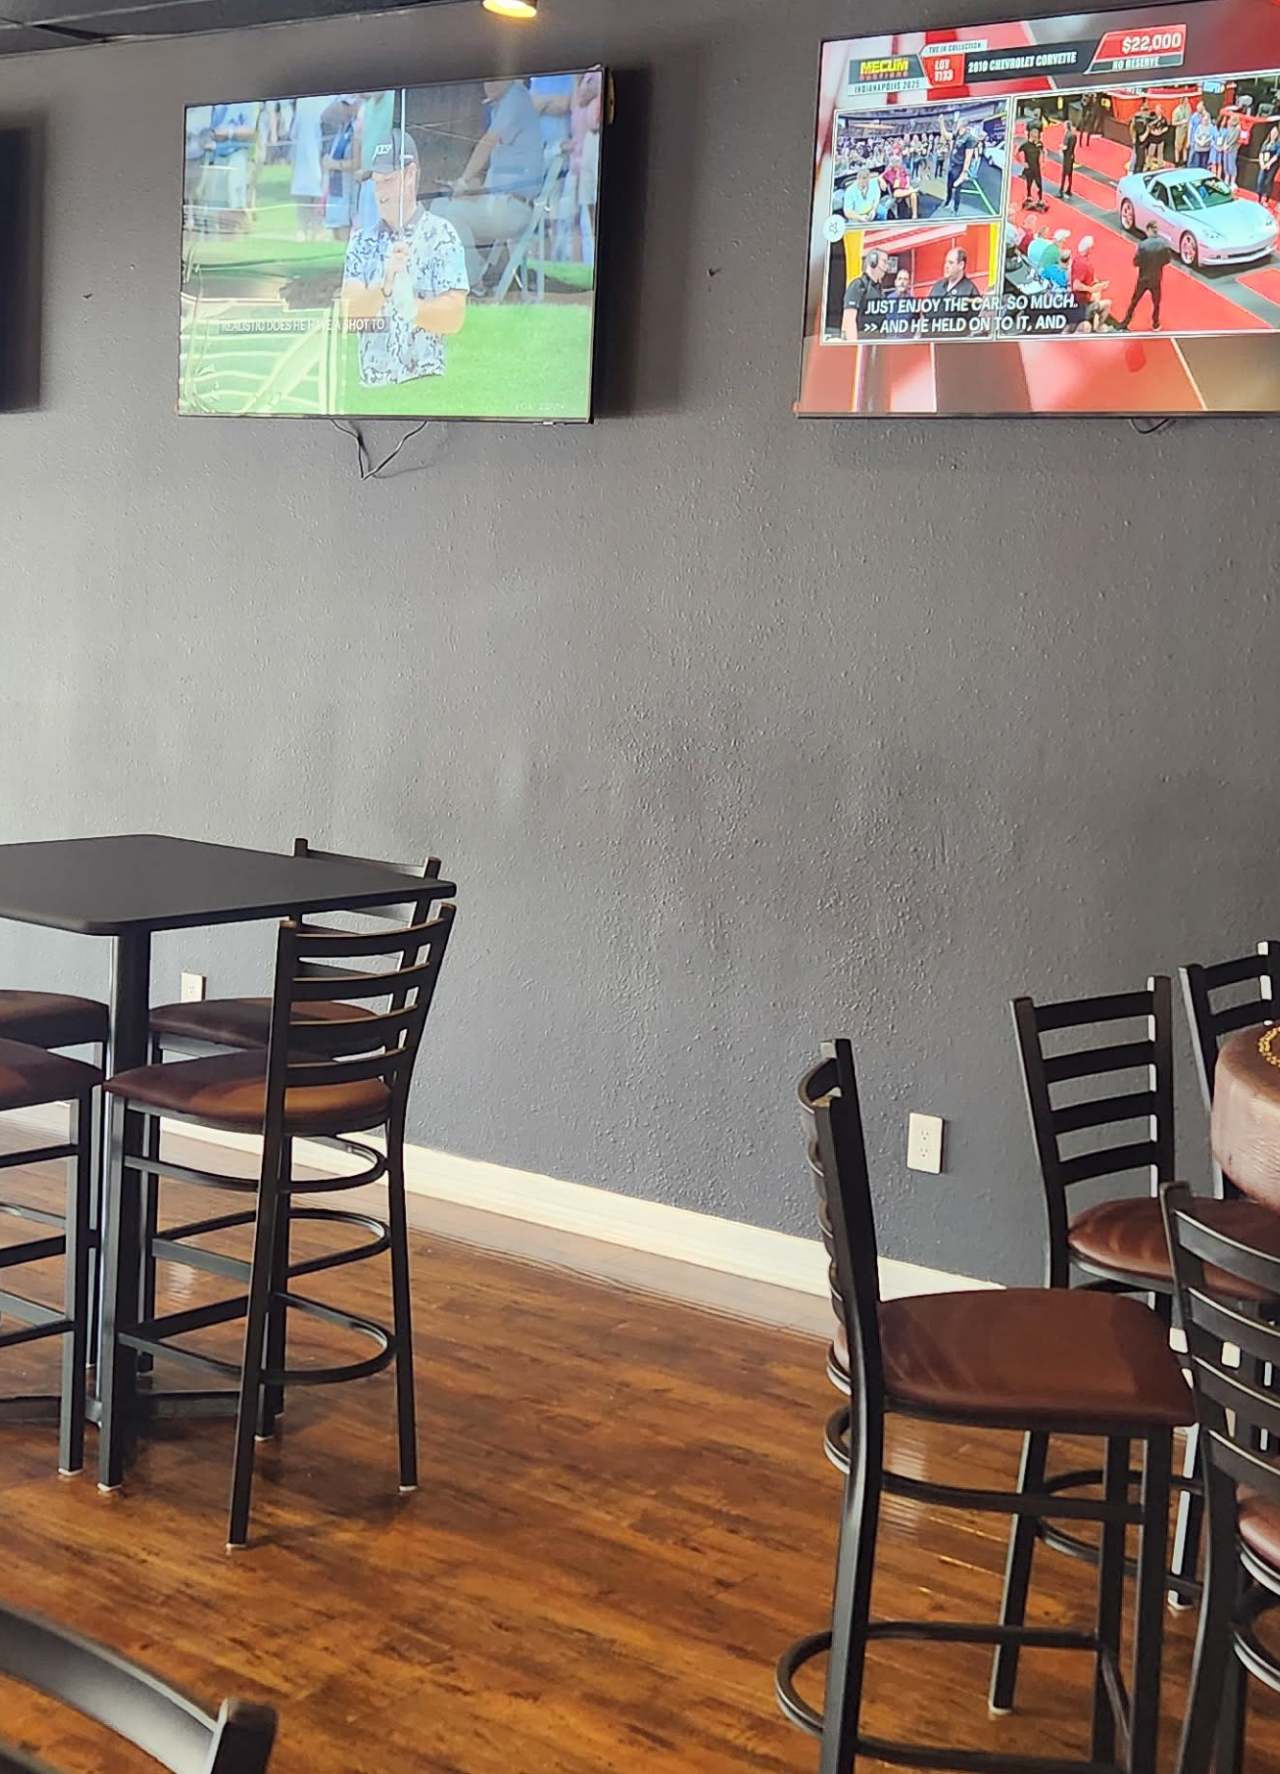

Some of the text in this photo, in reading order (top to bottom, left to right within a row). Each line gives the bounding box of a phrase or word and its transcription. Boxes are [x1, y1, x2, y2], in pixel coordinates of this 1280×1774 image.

[1121, 32, 1182, 54] $22,000
[860, 58, 909, 74] MECUM
[935, 59, 950, 70] LOT
[989, 55, 1035, 71] CHEVROLET
[1035, 51, 1078, 67] CORVETTE
[865, 300, 895, 315] JUST
[897, 299, 940, 314] ENJOY
[944, 298, 969, 312] THE
[1007, 296, 1028, 310] SO
[370, 317, 386, 330] TO
[880, 319, 909, 334] AND
[911, 319, 929, 333] HE
[932, 318, 967, 332] HELD
[969, 317, 991, 332] ON
[993, 316, 1014, 331] TO
[1016, 315, 1033, 333] IT,
[1035, 315, 1067, 330] AND
